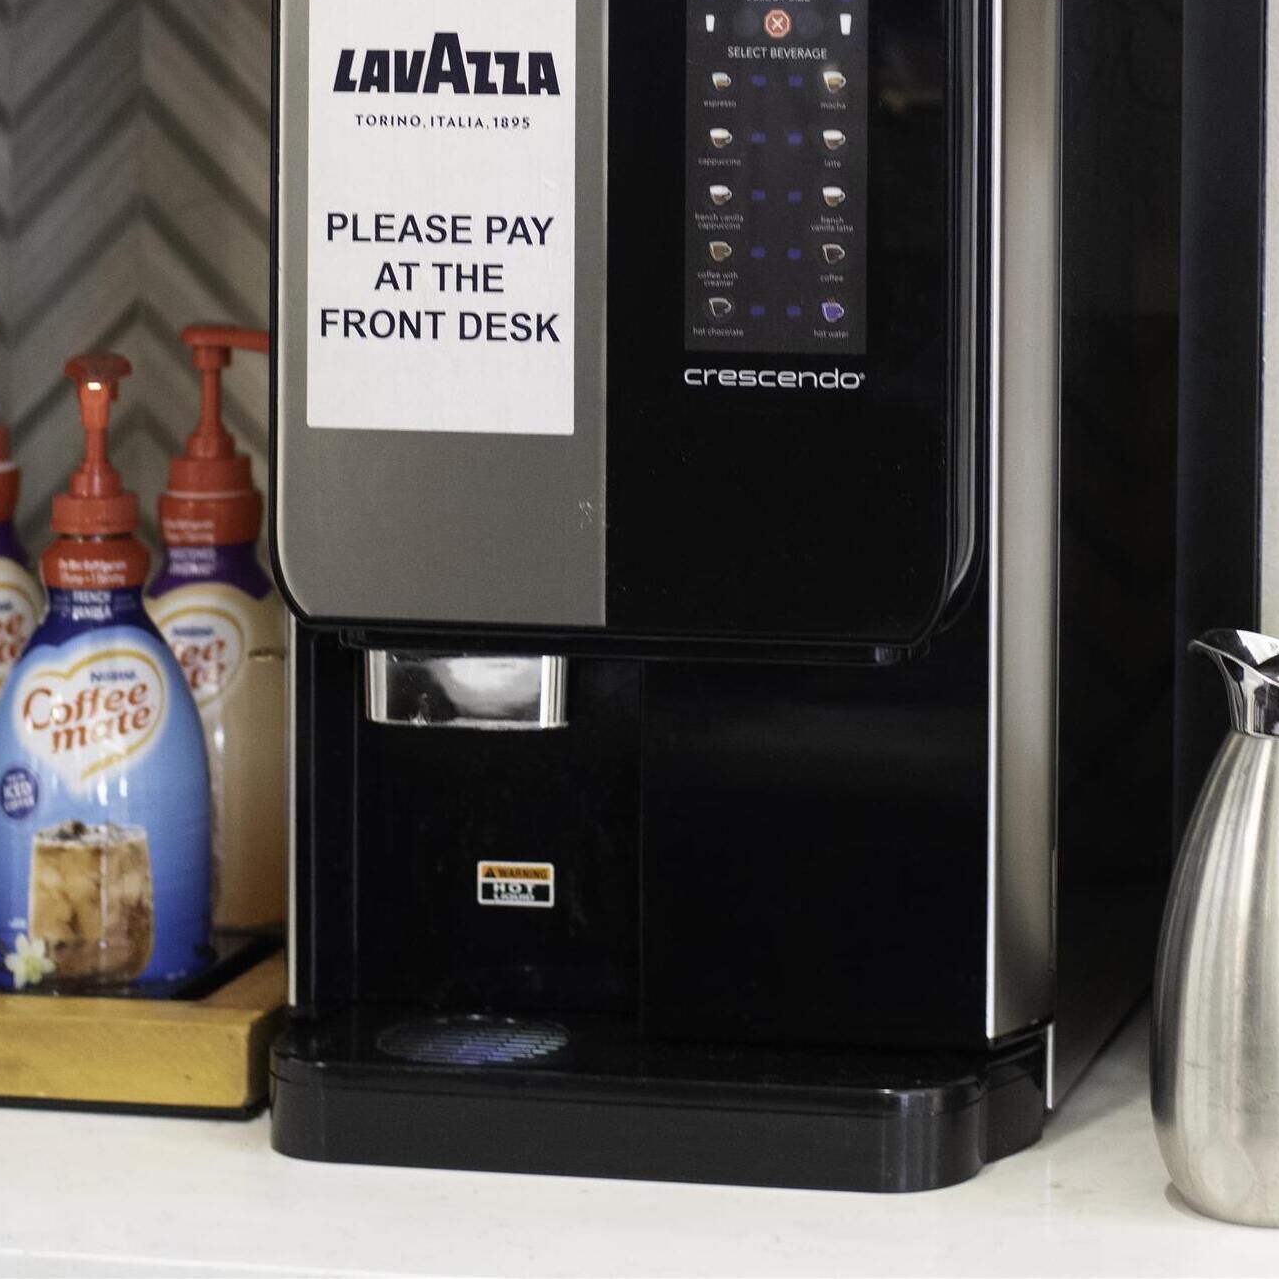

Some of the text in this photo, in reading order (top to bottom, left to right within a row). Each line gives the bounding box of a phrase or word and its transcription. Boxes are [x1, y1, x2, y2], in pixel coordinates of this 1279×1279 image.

[333, 31, 561, 96] LAVAZZA
[727, 46, 828, 60] SELECT BEVERAGE
[492, 116, 531, 130] 1895
[327, 211, 555, 246] PLEASE PAY
[374, 262, 505, 293] AT THE
[319, 308, 561, 343] FRONT DESK
[22, 683, 148, 731] Coffee
[50, 706, 151, 754] mate
[493, 883, 536, 894] HOT
